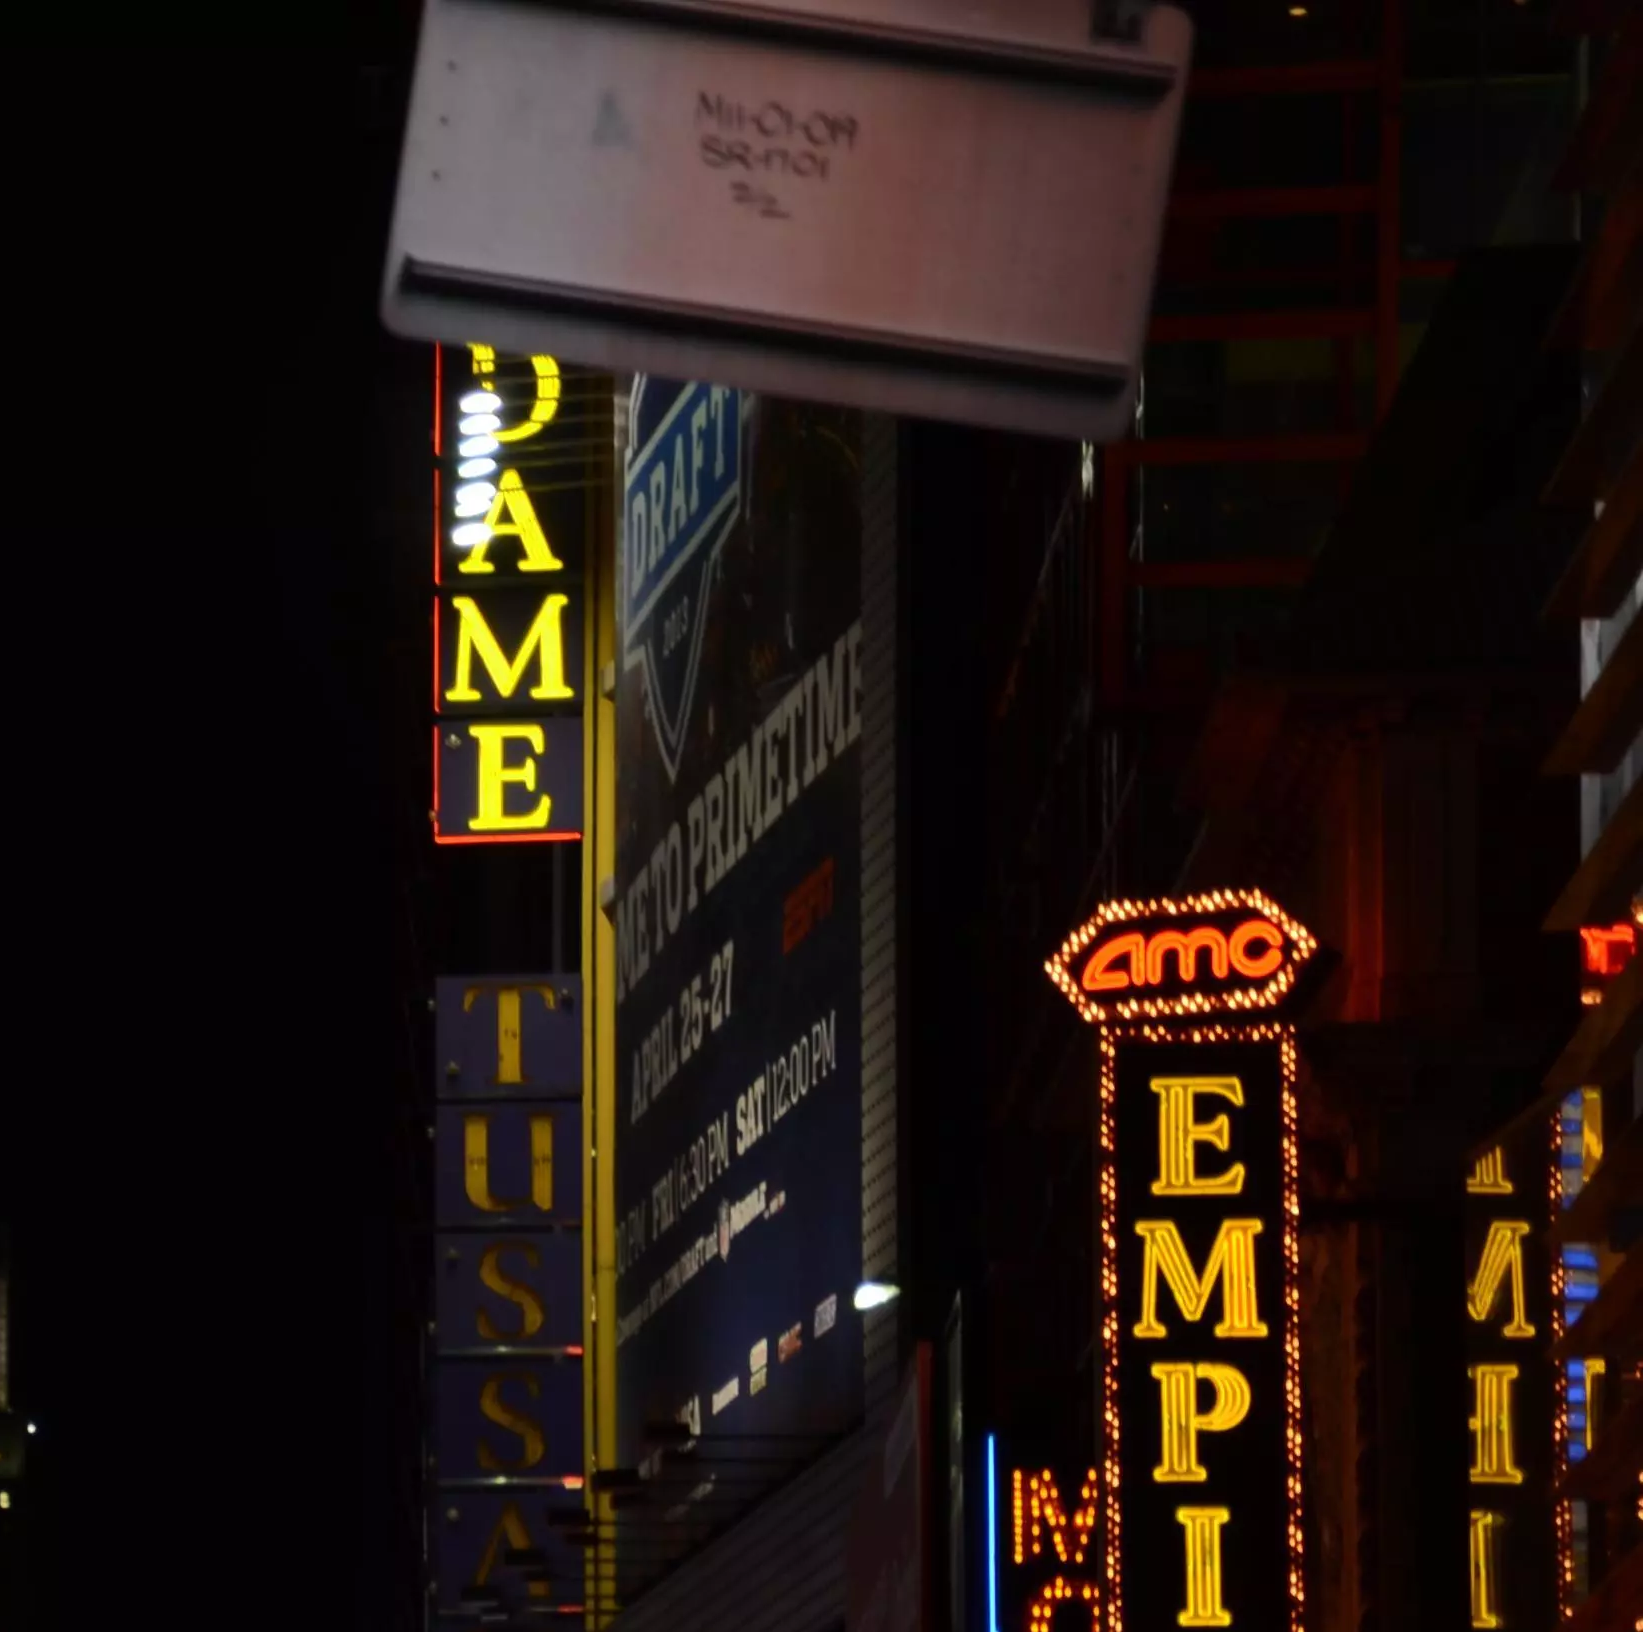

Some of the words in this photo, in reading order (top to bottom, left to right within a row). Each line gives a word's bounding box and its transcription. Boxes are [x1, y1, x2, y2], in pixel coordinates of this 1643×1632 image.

[632, 384, 730, 598] DRAFT
[651, 820, 683, 955] TO
[631, 1006, 677, 1125] APRIL
[680, 938, 734, 1064] 25-27
[812, 1008, 837, 1088] PM
